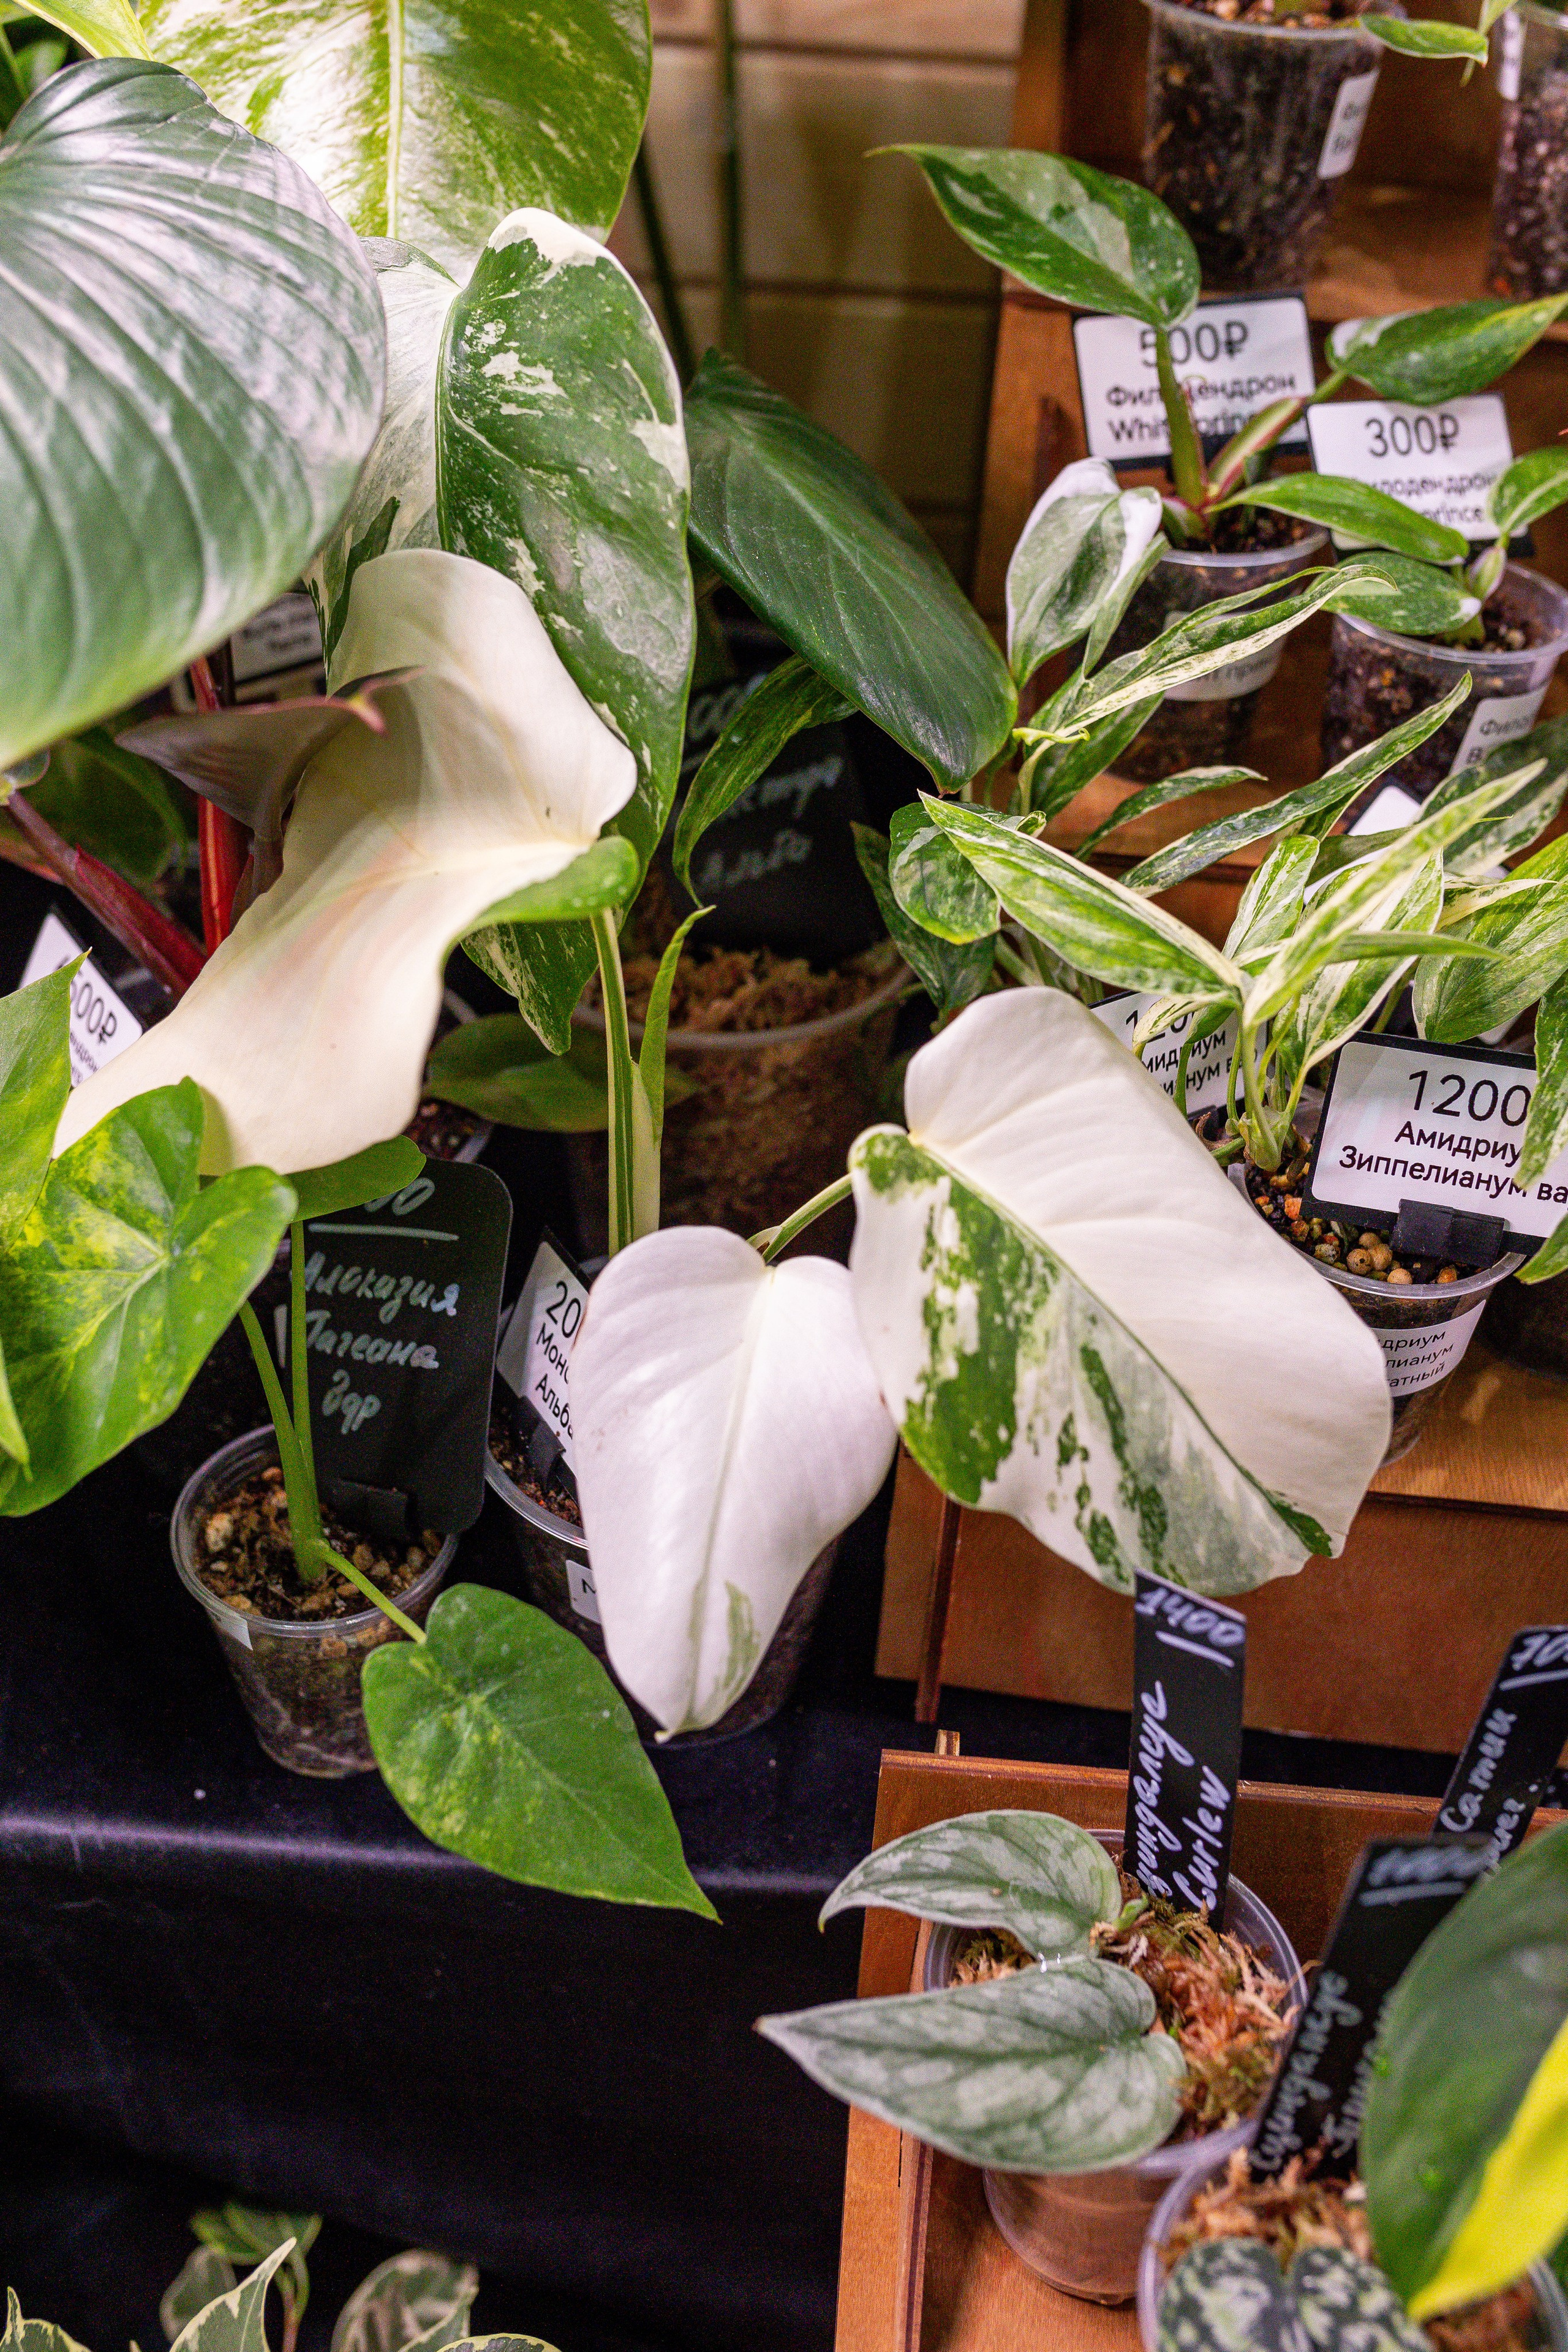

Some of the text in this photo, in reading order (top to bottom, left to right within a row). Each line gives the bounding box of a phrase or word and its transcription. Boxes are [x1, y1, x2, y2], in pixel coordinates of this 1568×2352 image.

[1394, 1121, 1523, 1167] Амидриу
[1339, 1145, 1568, 1212] Зиппелианум ва
[545, 1281, 581, 1338] 20
[1379, 1331, 1446, 1352] дриум
[1385, 1343, 1454, 1369] лианум
[1387, 1361, 1446, 1388] атный
[1134, 1587, 1245, 1646] 1400
